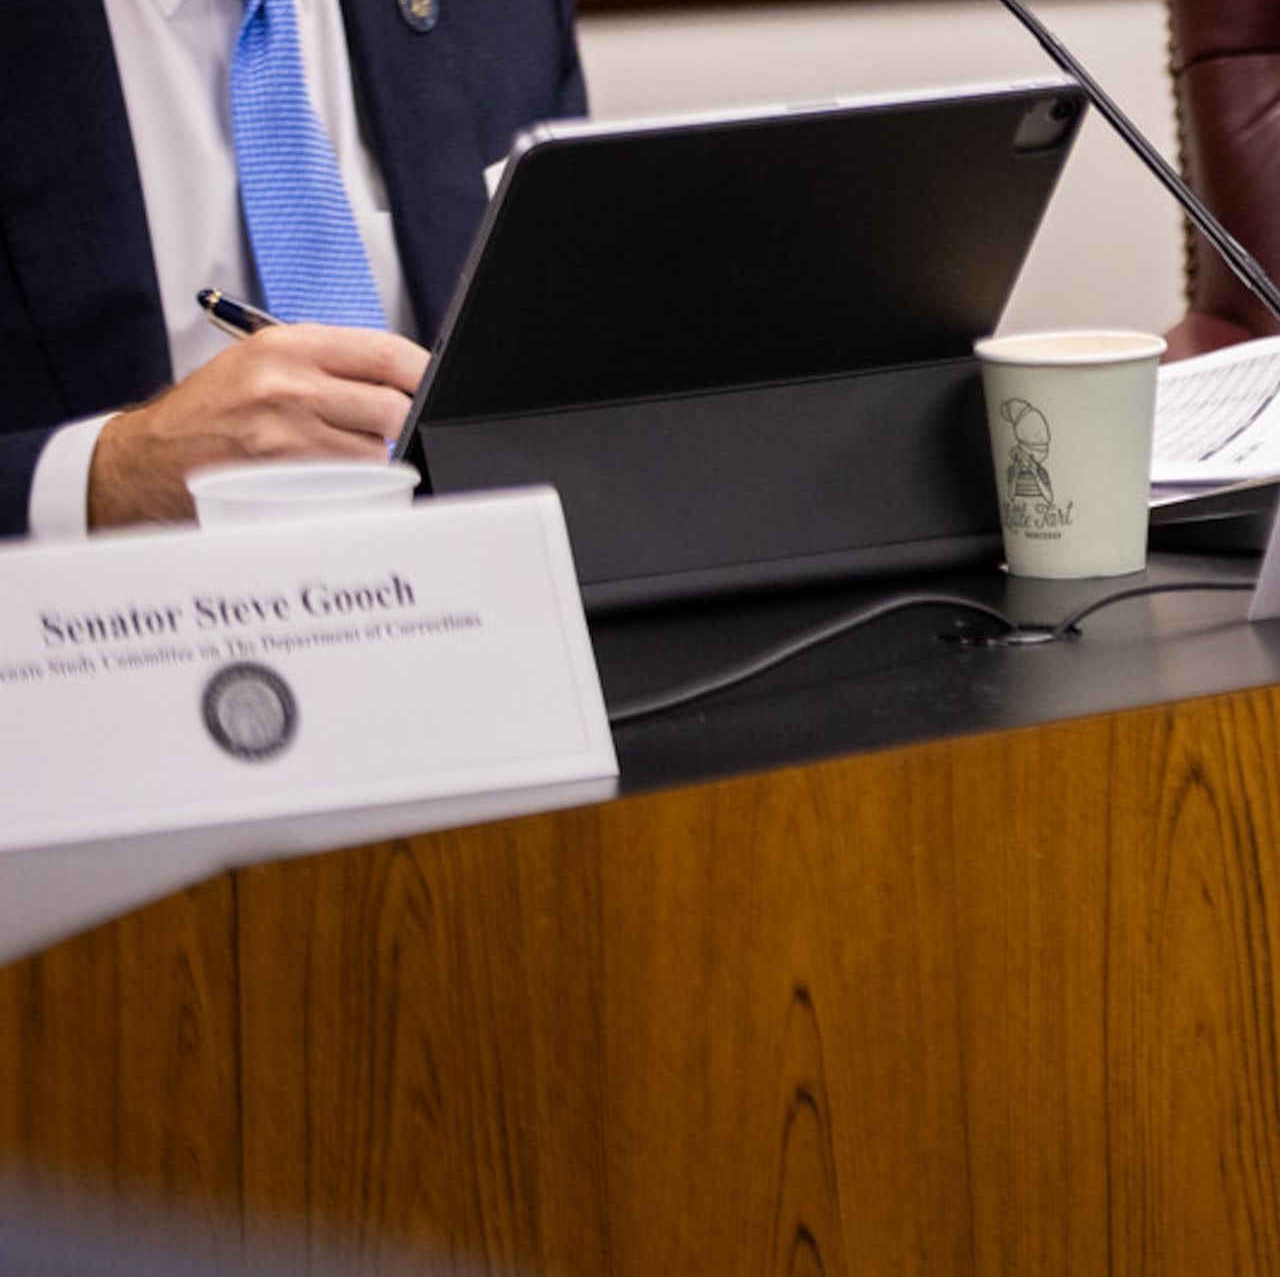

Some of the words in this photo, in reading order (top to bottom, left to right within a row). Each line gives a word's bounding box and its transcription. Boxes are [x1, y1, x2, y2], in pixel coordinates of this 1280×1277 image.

[39, 608, 182, 645] Senator
[193, 593, 290, 627] Steve
[300, 572, 416, 617] Gooch
